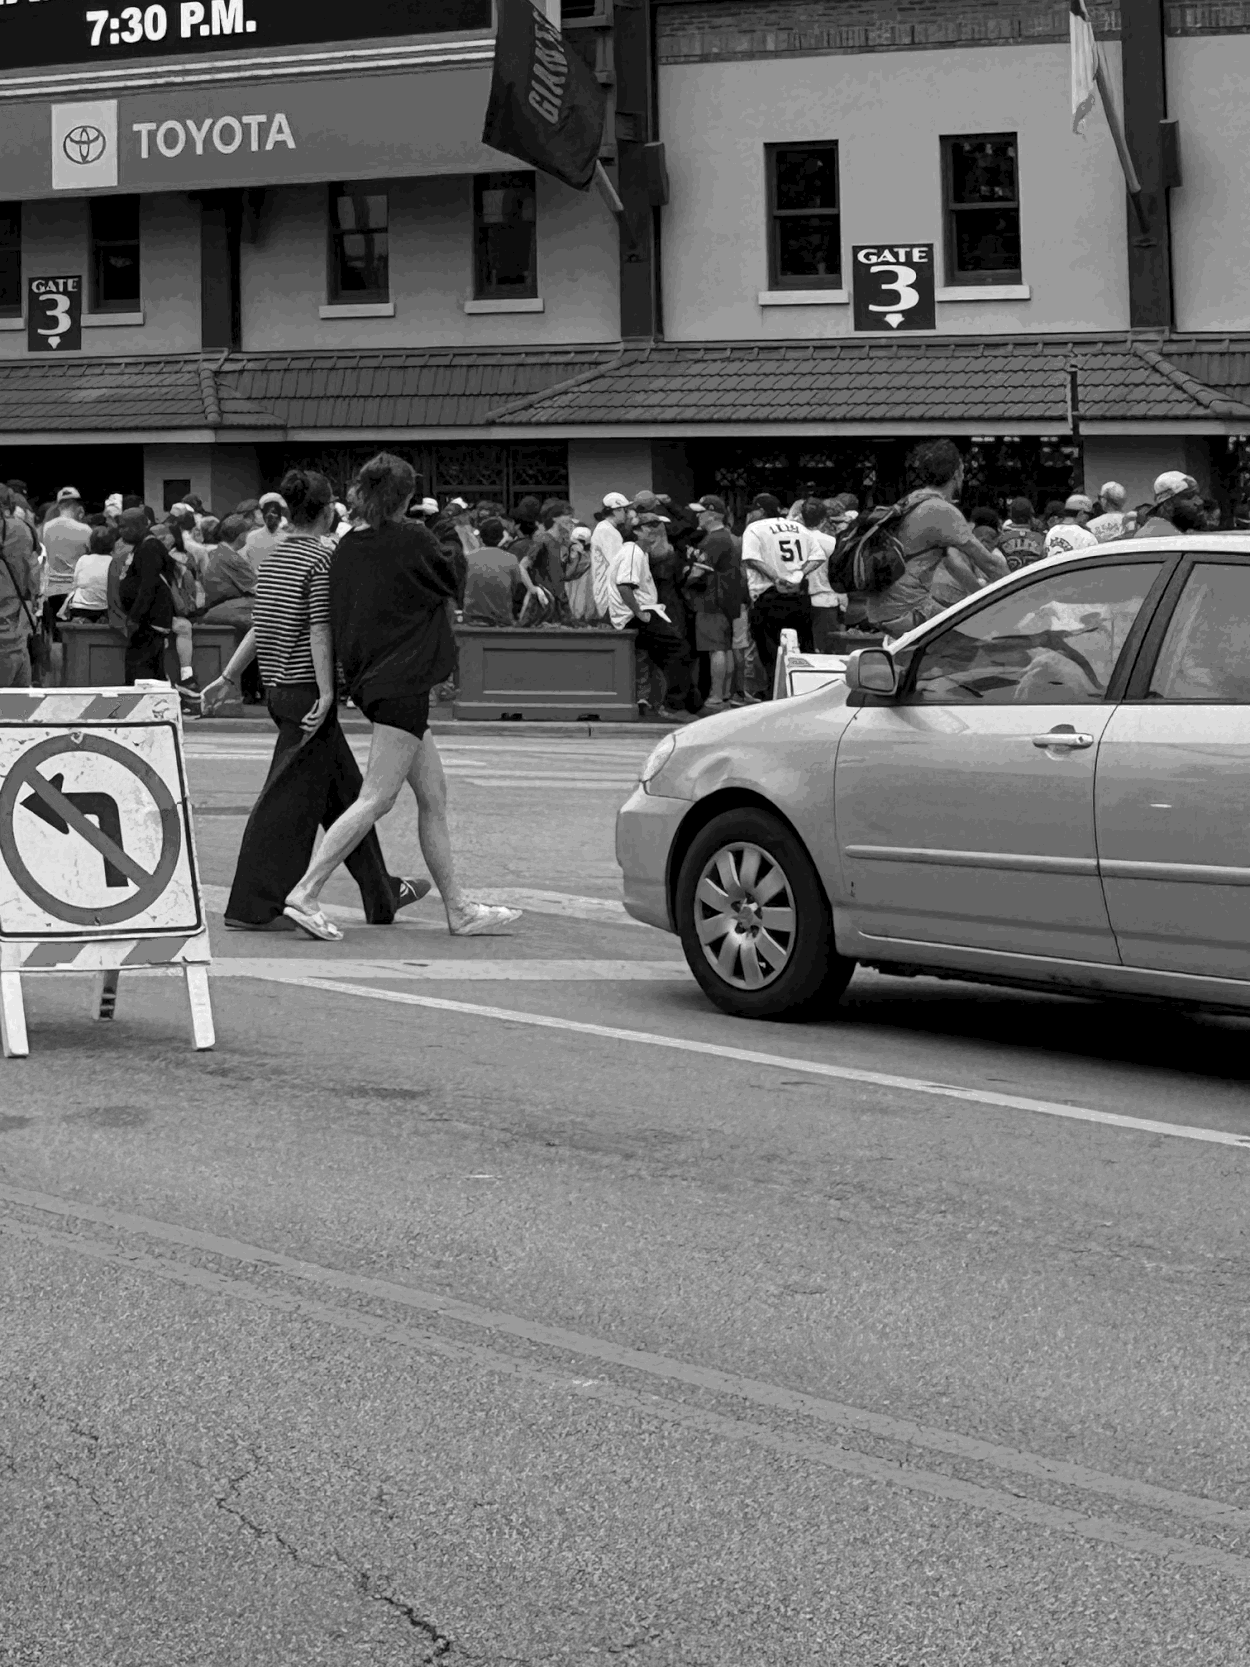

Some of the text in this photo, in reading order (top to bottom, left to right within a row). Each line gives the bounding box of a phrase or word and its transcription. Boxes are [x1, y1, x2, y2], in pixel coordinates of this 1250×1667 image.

[86, 4, 167, 46] 7:30
[133, 113, 297, 159] TOYOTA
[856, 246, 929, 264] GATE
[31, 277, 79, 293] GATE
[868, 264, 920, 313] 3
[37, 293, 72, 336] 3
[778, 538, 804, 563] 51
